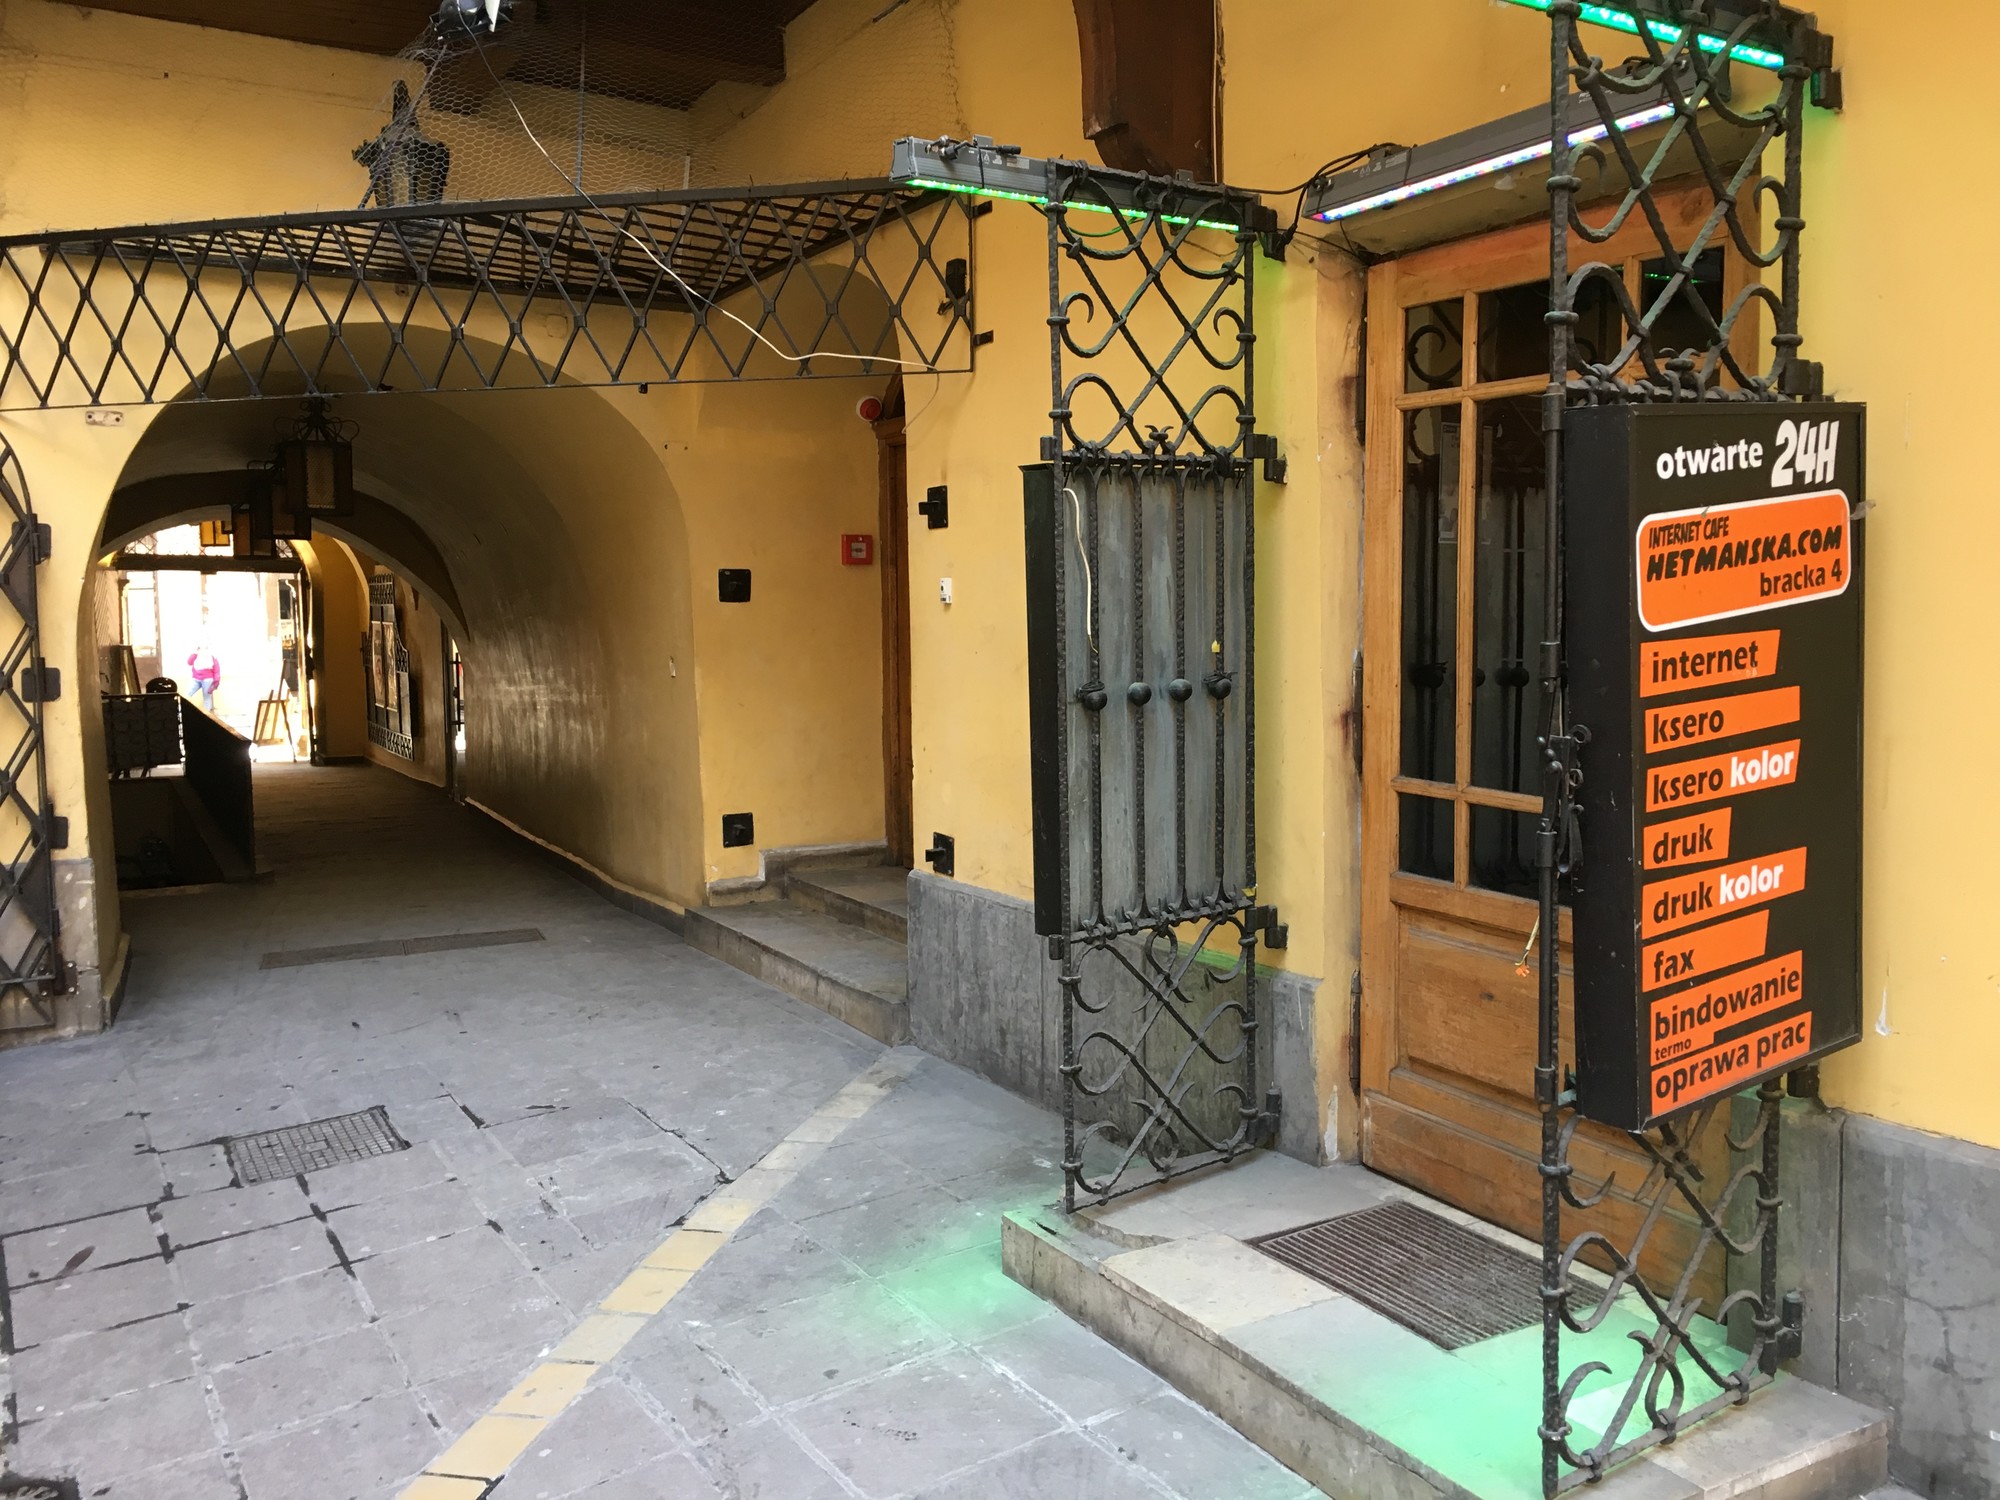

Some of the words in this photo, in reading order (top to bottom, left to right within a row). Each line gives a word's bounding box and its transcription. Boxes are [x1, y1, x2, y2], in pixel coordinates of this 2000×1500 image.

[1656, 438, 1763, 480] otwarte
[1771, 419, 1840, 488] 24H
[1647, 525, 1842, 582] HETMANSKA.COM
[1649, 521, 1702, 550] INTERNET
[1704, 516, 1729, 540] CAFE
[1760, 564, 1825, 597] bracka
[1831, 559, 1842, 582] 4
[1652, 640, 1758, 683] internet
[1653, 710, 1724, 744] ksero
[1653, 767, 1724, 805] ksero
[1730, 750, 1794, 788] kolor
[1653, 823, 1713, 864] druk
[1653, 881, 1713, 923] druk
[1719, 864, 1784, 904] kolor
[1654, 949, 1695, 983] fax
[1655, 968, 1800, 1041] bindowanie
[1655, 1037, 1691, 1061] termo
[1656, 1043, 1749, 1103] oprawa
[1757, 1021, 1806, 1068] prac
